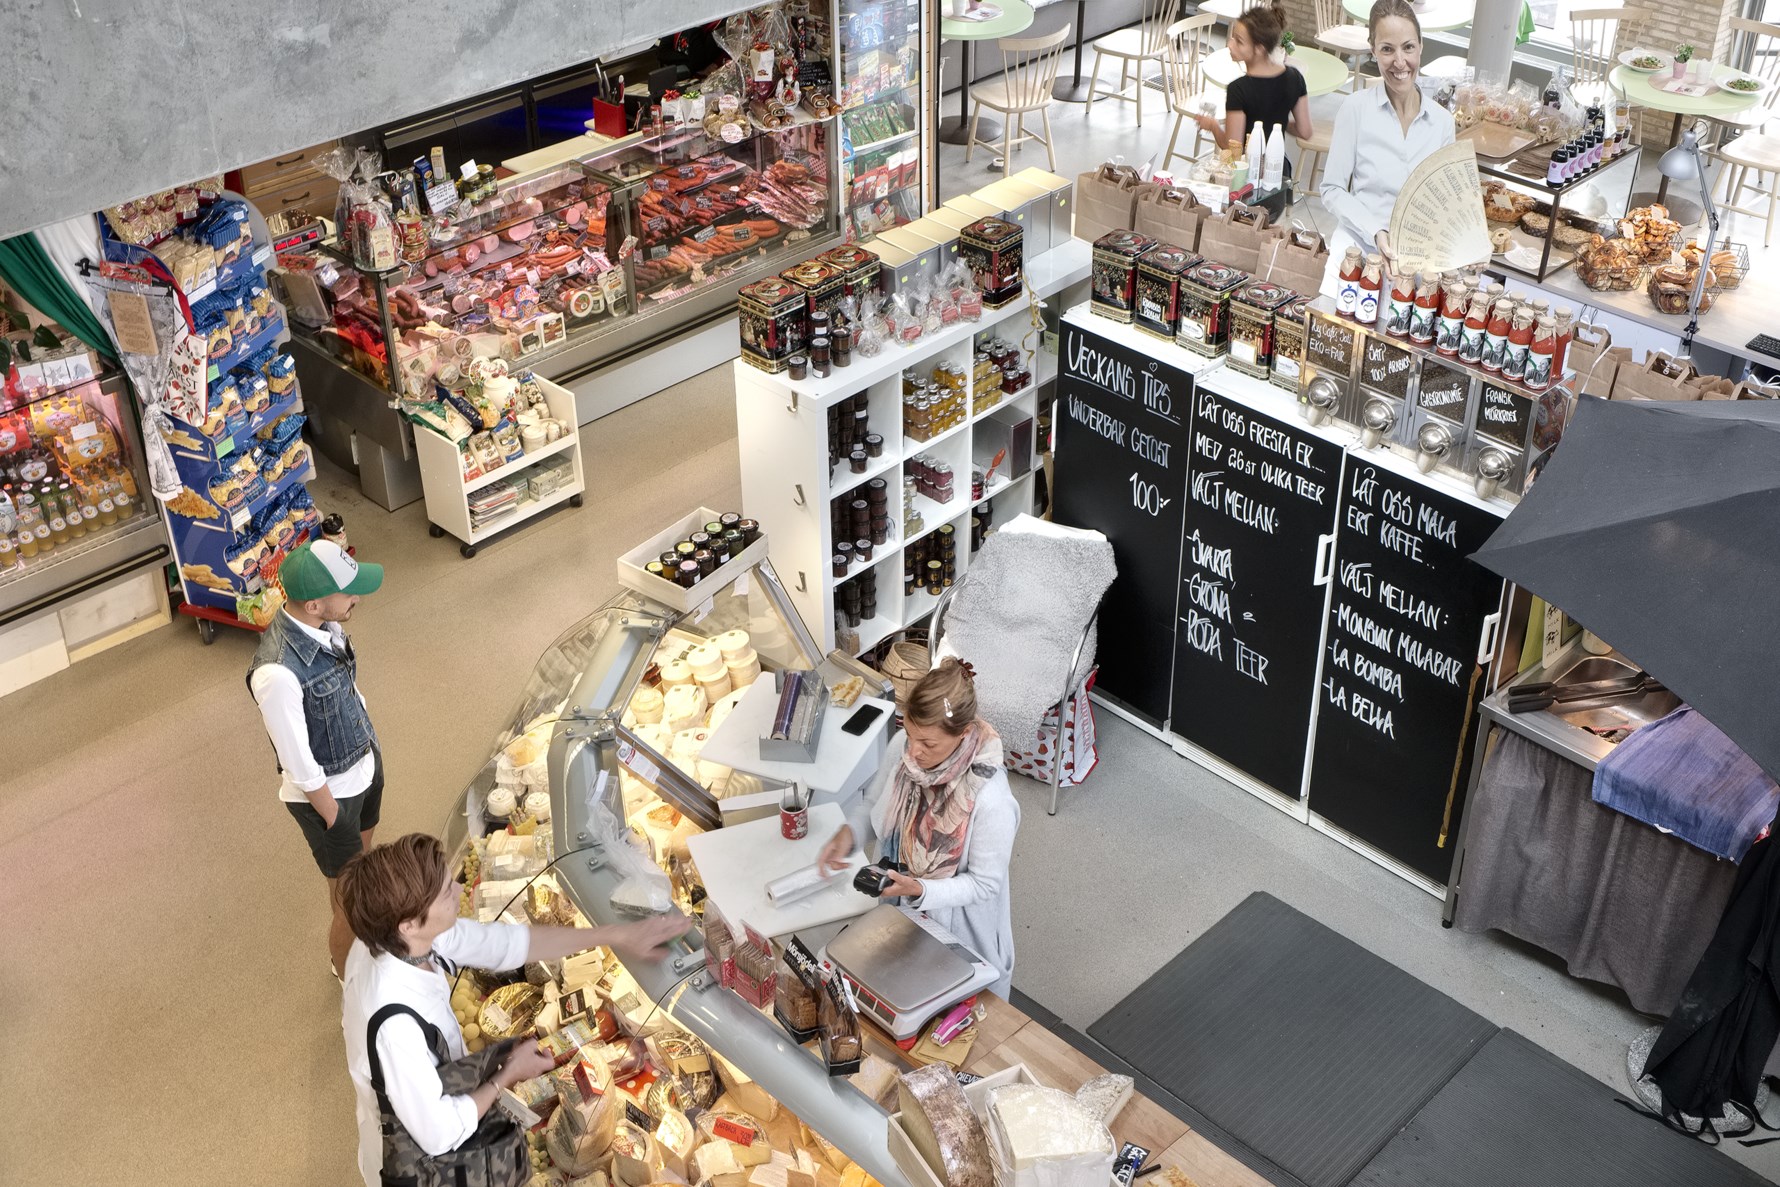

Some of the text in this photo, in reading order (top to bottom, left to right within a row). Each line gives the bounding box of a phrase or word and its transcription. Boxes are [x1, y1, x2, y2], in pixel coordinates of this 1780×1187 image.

[1309, 338, 1324, 355] EKO
[1420, 386, 1464, 407] GASTRONOMIE
[1485, 387, 1514, 407] FRANSK
[1131, 427, 1171, 468] GETOST
[1199, 394, 1221, 424] LÅT
[1223, 409, 1245, 436] OSS
[1250, 421, 1291, 460] FRESTA
[1196, 432, 1222, 458] MED
[1260, 461, 1292, 492] OLIKA
[1295, 475, 1325, 505] TEER
[1192, 469, 1224, 510] VÄLJ
[1352, 467, 1457, 548] LÅT OSS MALA
[1347, 505, 1374, 536] ERT
[1340, 559, 1373, 598] VÄLJ
[1233, 638, 1268, 685] TEER
[1397, 632, 1463, 688] MALABAR
[1351, 692, 1396, 740] BELLA
